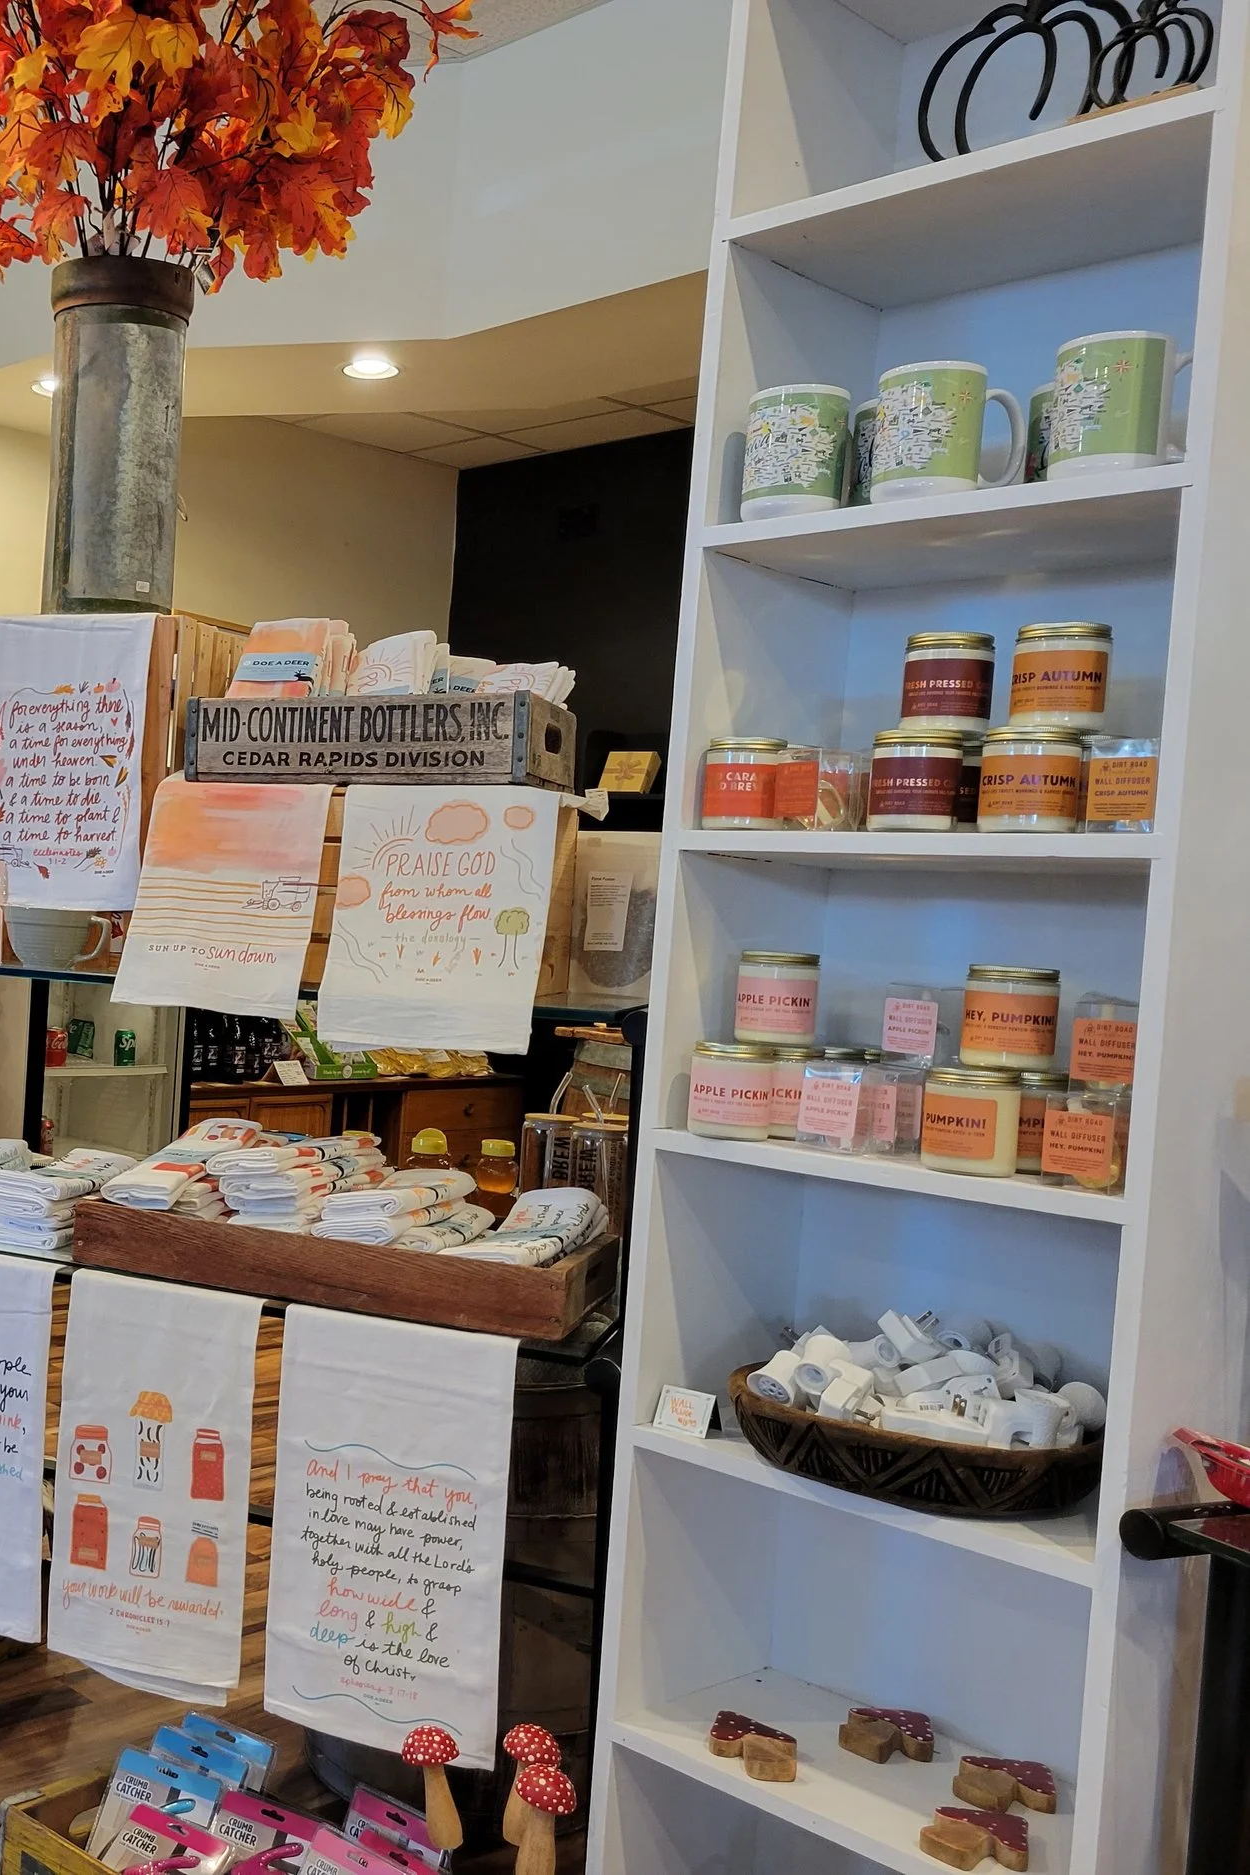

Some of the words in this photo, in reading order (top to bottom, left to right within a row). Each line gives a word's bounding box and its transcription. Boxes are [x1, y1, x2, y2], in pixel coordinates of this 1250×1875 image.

[929, 680, 973, 689] PRESSED
[1040, 671, 1102, 684] AUTUMN
[9, 700, 27, 729] for
[29, 699, 90, 722] everything
[96, 695, 123, 714] there
[16, 724, 34, 734] is
[39, 723, 47, 733] a
[53, 721, 103, 734] season,
[201, 706, 355, 743] MID-CONTINENT
[358, 703, 465, 744] BOTTLERS,
[469, 701, 509, 742] INC.
[9, 740, 17, 749] a
[22, 737, 50, 750] time
[53, 735, 68, 755] for
[72, 734, 128, 754] everything
[13, 753, 46, 768] under
[52, 753, 97, 768] heaven.
[222, 751, 290, 767] CEDAR
[298, 751, 378, 768] RAPIDS
[384, 750, 485, 767] DIVISION
[896, 778, 941, 787] PRESSED
[982, 775, 1014, 786] CRISP
[1019, 774, 1076, 787] AUTUMN
[1116, 776, 1150, 784] DIFFUSER
[3, 831, 11, 842] a
[17, 829, 50, 842] time
[54, 827, 71, 843] to
[74, 826, 117, 842] harvest.
[385, 851, 453, 877] PRAISE
[458, 850, 496, 876] GOD
[378, 881, 419, 910] from
[425, 884, 471, 897] whom
[474, 883, 492, 898] all
[384, 903, 456, 931] blessings
[457, 904, 492, 933] flow.
[394, 932, 415, 943] the
[421, 929, 466, 953] doxology
[148, 944, 169, 952] SUN
[173, 944, 187, 952] UP
[191, 947, 206, 956] TO
[738, 993, 764, 1005] APPLE
[965, 1009, 987, 1022] HEY,
[992, 1012, 1055, 1026] PUMPKIN!
[1079, 1038, 1097, 1046] WALL
[1100, 1039, 1135, 1049] DIFFUSER
[1096, 1052, 1134, 1060] PUMPKIN!
[693, 1083, 726, 1097] APPLE
[925, 1112, 987, 1129] PUMPKIN!
[1050, 1130, 1068, 1139] WALL
[1070, 1132, 1106, 1143] DIFFUSER
[1068, 1144, 1104, 1154] PUMPKIN!
[0, 1384, 29, 1413] your
[306, 1459, 339, 1481] And
[346, 1463, 352, 1480] I
[357, 1472, 398, 1494] pray
[402, 1476, 438, 1498] that
[444, 1487, 478, 1512] you,
[306, 1482, 339, 1513] being
[343, 1494, 383, 1514] rooted
[386, 1501, 398, 1516] &
[399, 1506, 477, 1531] established
[300, 1525, 351, 1550] together
[354, 1541, 384, 1557] with
[387, 1546, 408, 1562] all
[411, 1550, 432, 1569] the
[433, 1552, 475, 1575] Lord's
[63, 1579, 86, 1609] your
[88, 1581, 118, 1599] work
[119, 1584, 143, 1606] will
[144, 1588, 166, 1607] be
[116, 1610, 156, 1625] CHRONICLES
[125, 1775, 149, 1790] CRUMB
[116, 1782, 152, 1803] CATCHER
[229, 1817, 254, 1833] CRUMB
[133, 1827, 156, 1842] CRUMB
[219, 1823, 257, 1847] CATCHER
[122, 1832, 158, 1855] CATCHER
